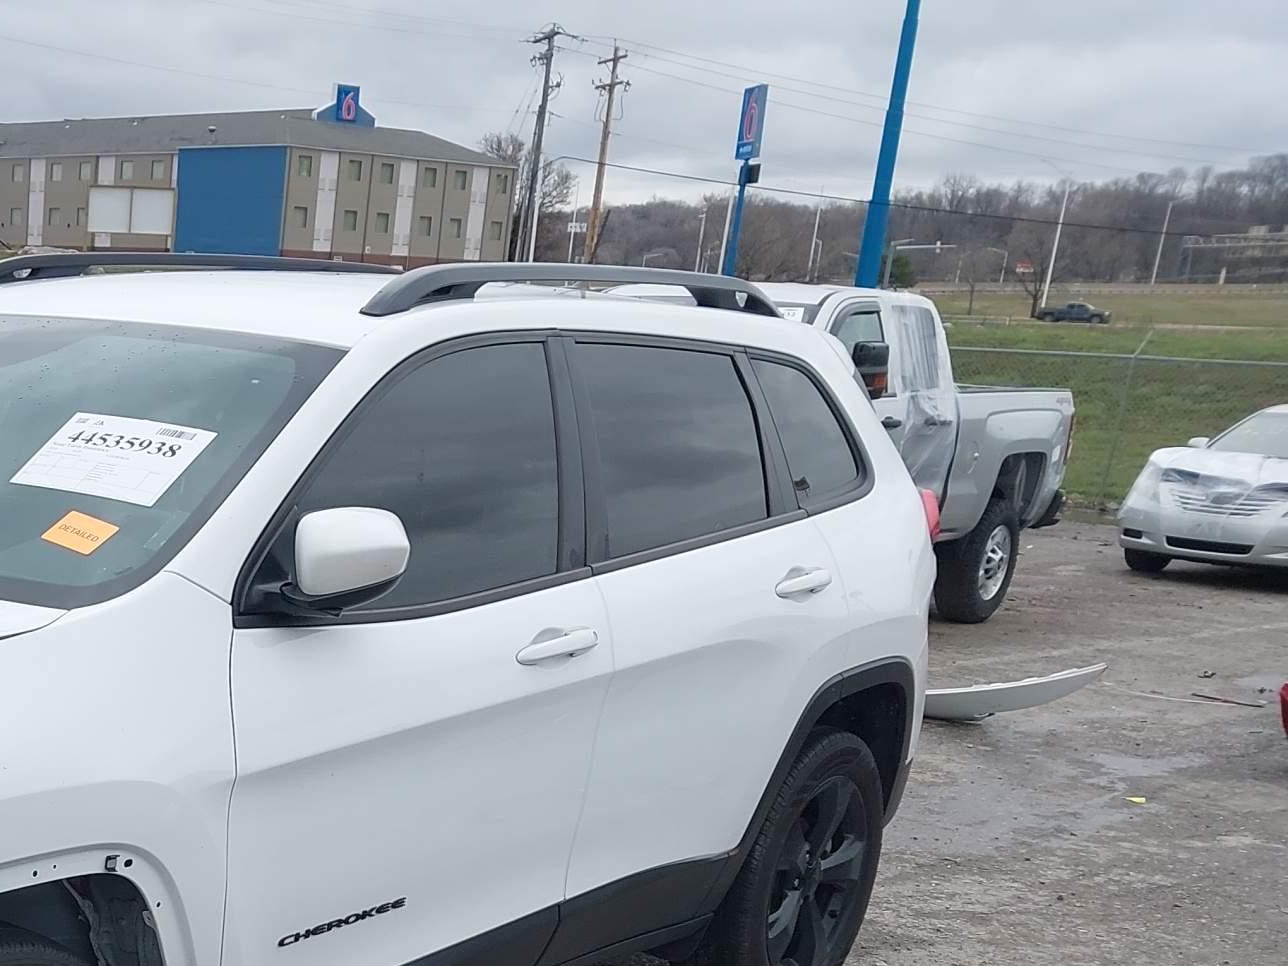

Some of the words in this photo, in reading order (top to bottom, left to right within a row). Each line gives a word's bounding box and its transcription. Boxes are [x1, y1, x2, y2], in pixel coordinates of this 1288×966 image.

[342, 91, 356, 121] 6
[744, 96, 759, 142] 6
[68, 430, 182, 457] 44535938
[58, 524, 100, 542] DETAILED
[278, 897, 407, 947] CHEROKEE
